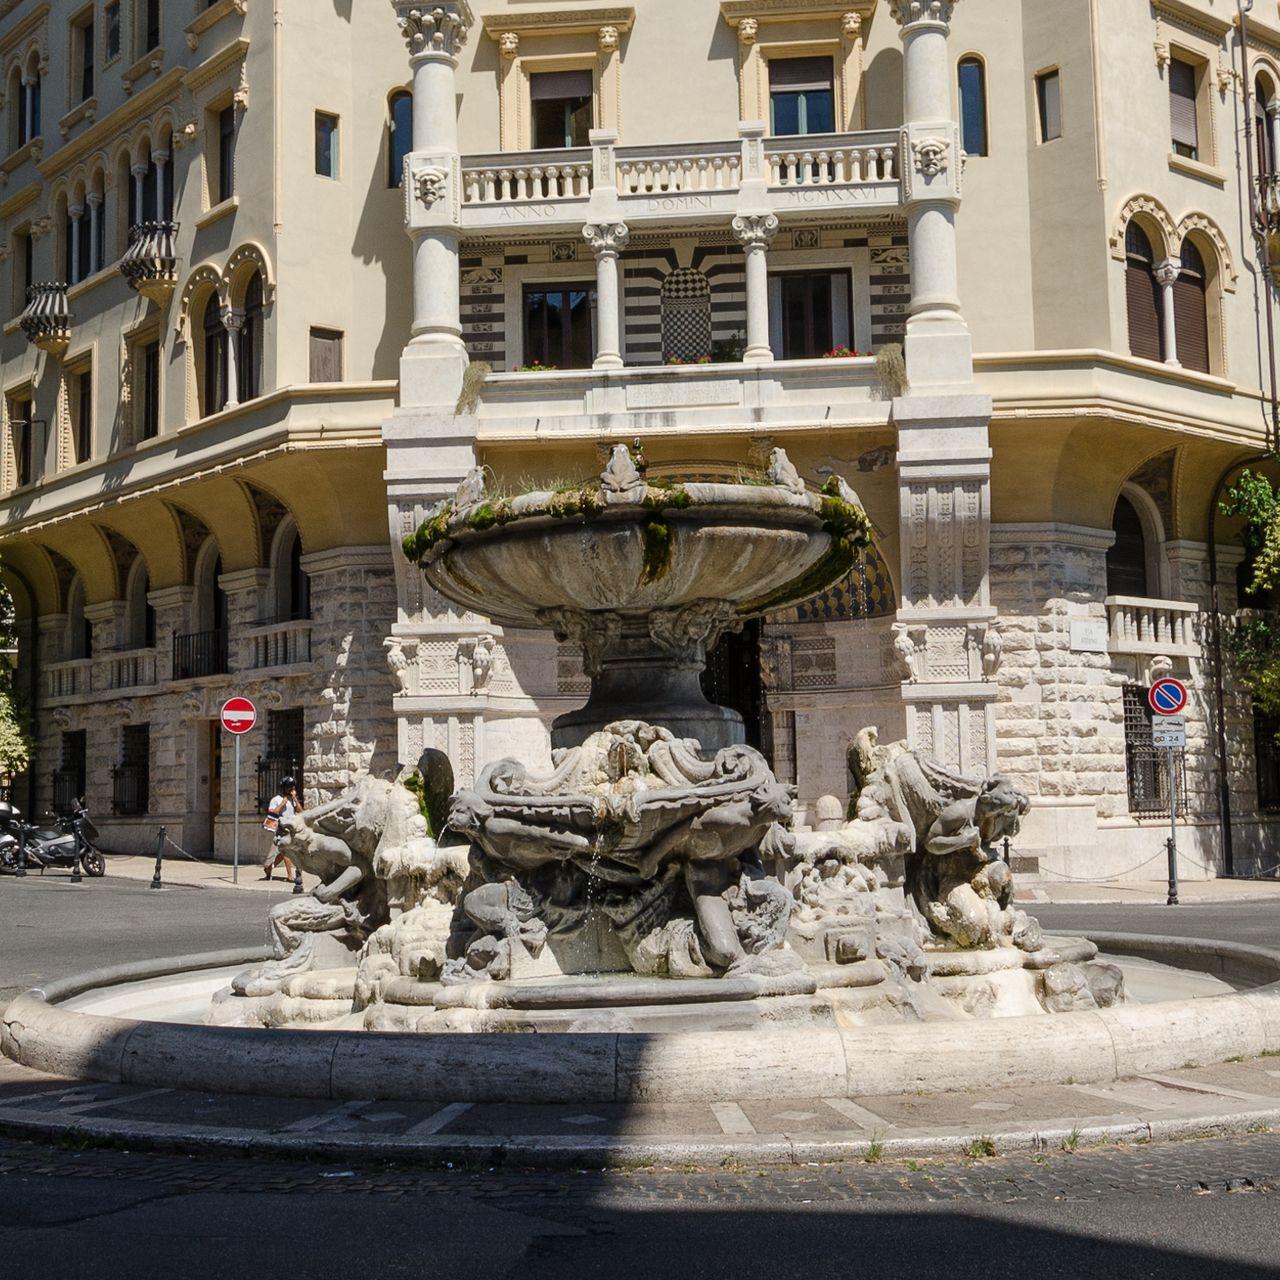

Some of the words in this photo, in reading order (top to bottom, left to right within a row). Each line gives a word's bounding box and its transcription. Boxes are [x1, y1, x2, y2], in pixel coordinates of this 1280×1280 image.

[499, 205, 557, 219] ANNO
[648, 196, 712, 211] DOMINI
[787, 186, 877, 204] MCMXXVI
